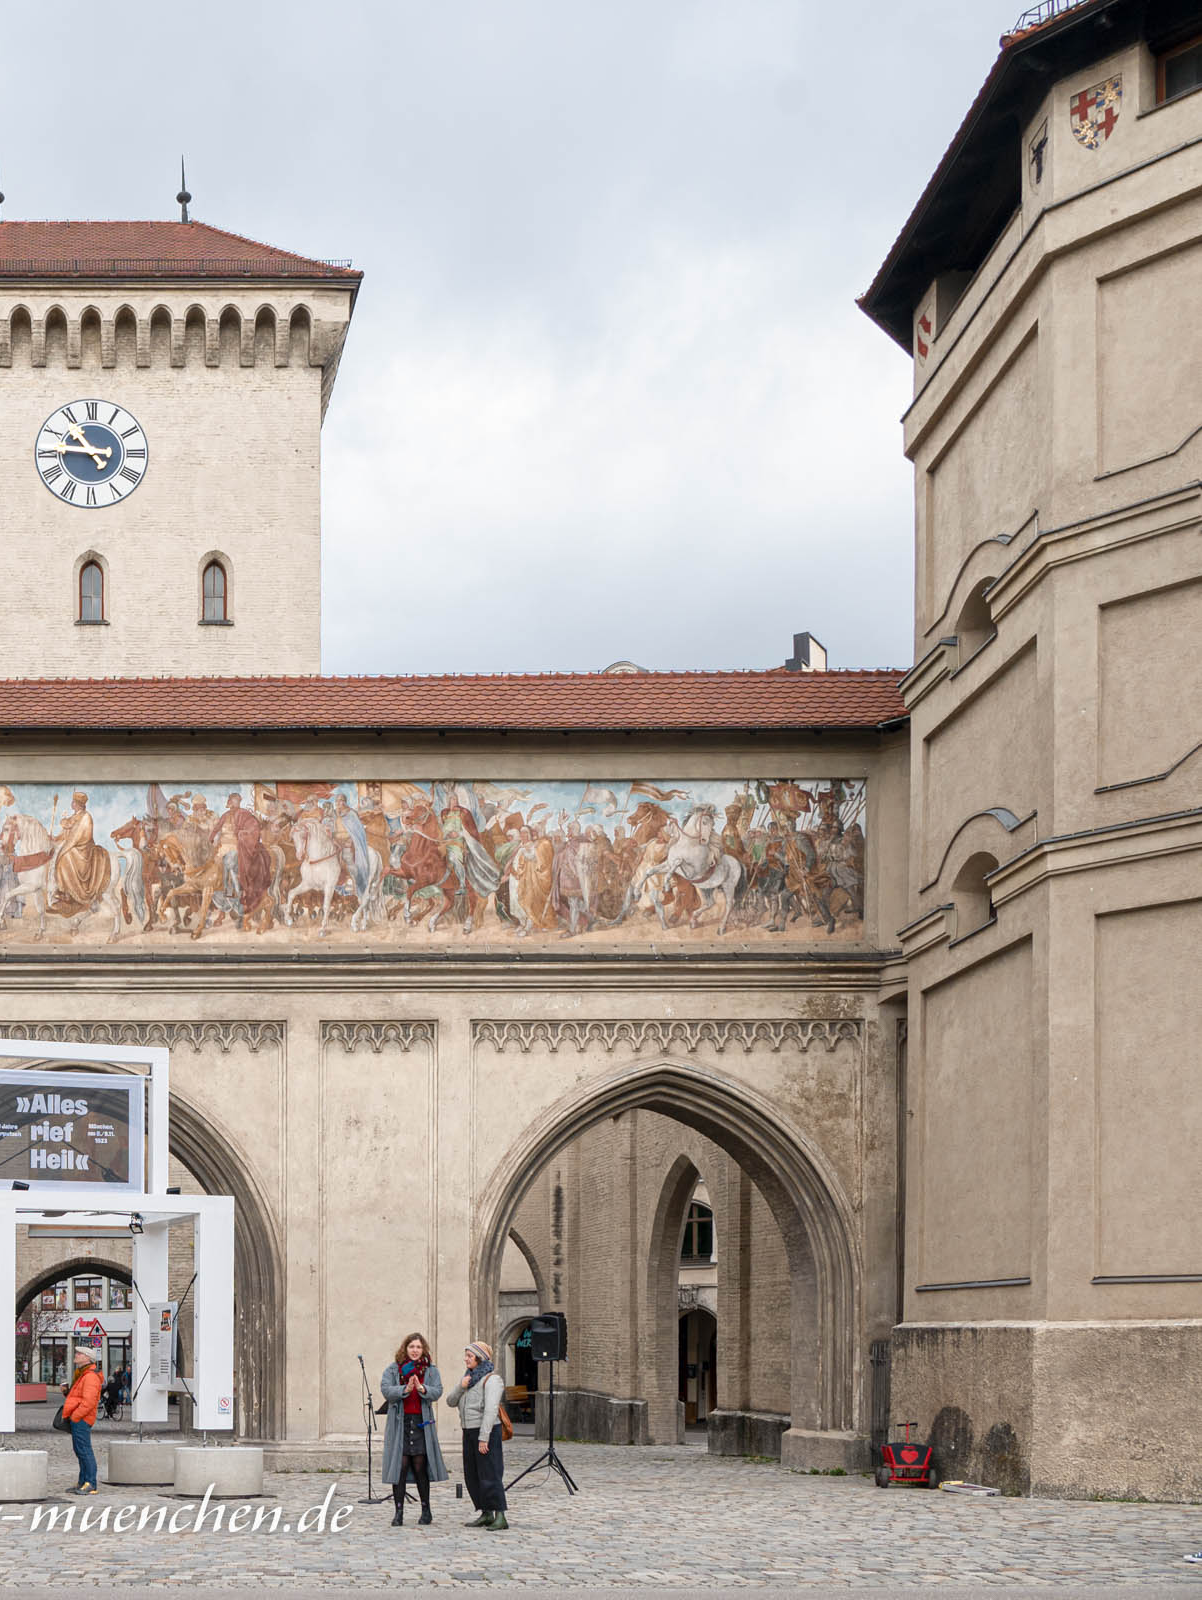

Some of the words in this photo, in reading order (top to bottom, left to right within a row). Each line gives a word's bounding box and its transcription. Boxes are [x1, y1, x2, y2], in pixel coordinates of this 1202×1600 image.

[16, 1093, 88, 1116] »Alles
[30, 1121, 74, 1142] rief
[30, 1148, 90, 1171] Heil«
